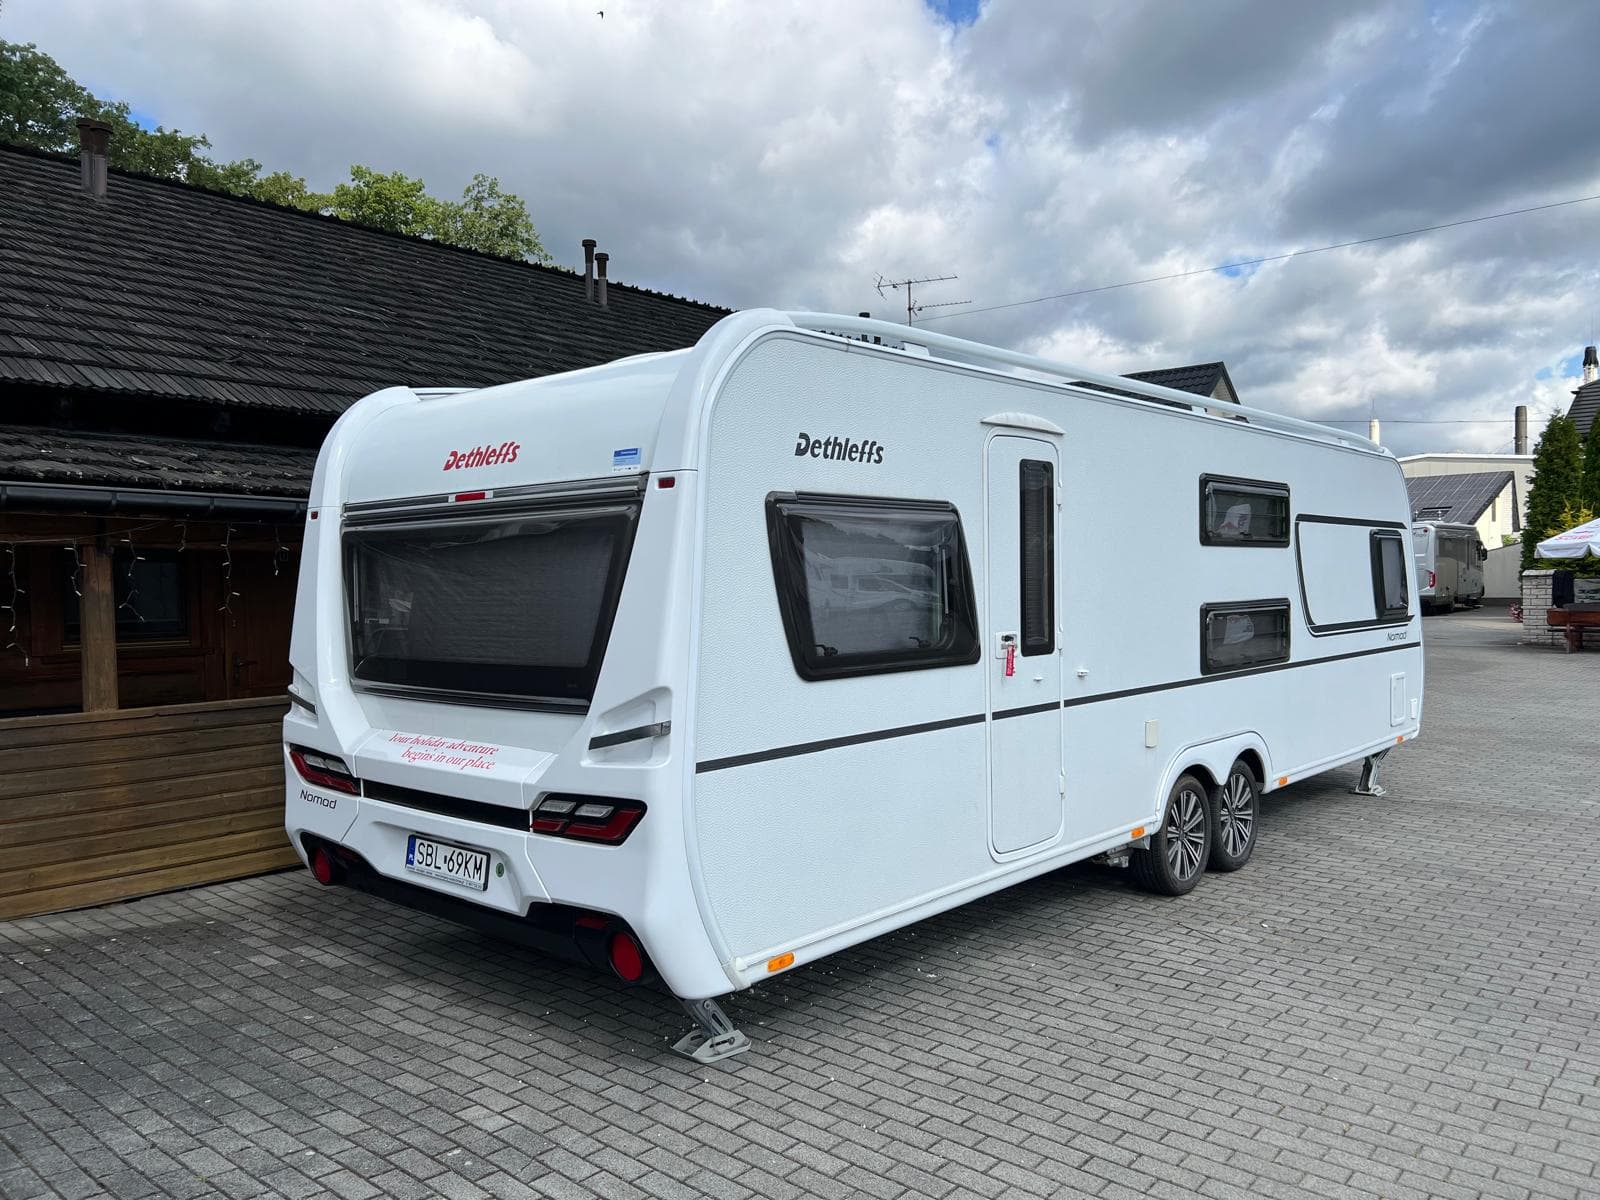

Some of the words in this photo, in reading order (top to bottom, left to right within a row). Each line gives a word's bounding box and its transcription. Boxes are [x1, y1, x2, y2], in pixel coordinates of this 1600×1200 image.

[443, 441, 521, 471] Dethleffs
[795, 432, 884, 464] Dethleffs
[401, 746, 433, 763] begins
[433, 752, 446, 763] in
[446, 756, 466, 766] our
[460, 755, 496, 770] place
[410, 735, 446, 750] holiday
[446, 740, 499, 755] adventure
[300, 789, 337, 809] Nomad
[416, 842, 442, 870] SBL
[447, 849, 484, 881] 69KM
